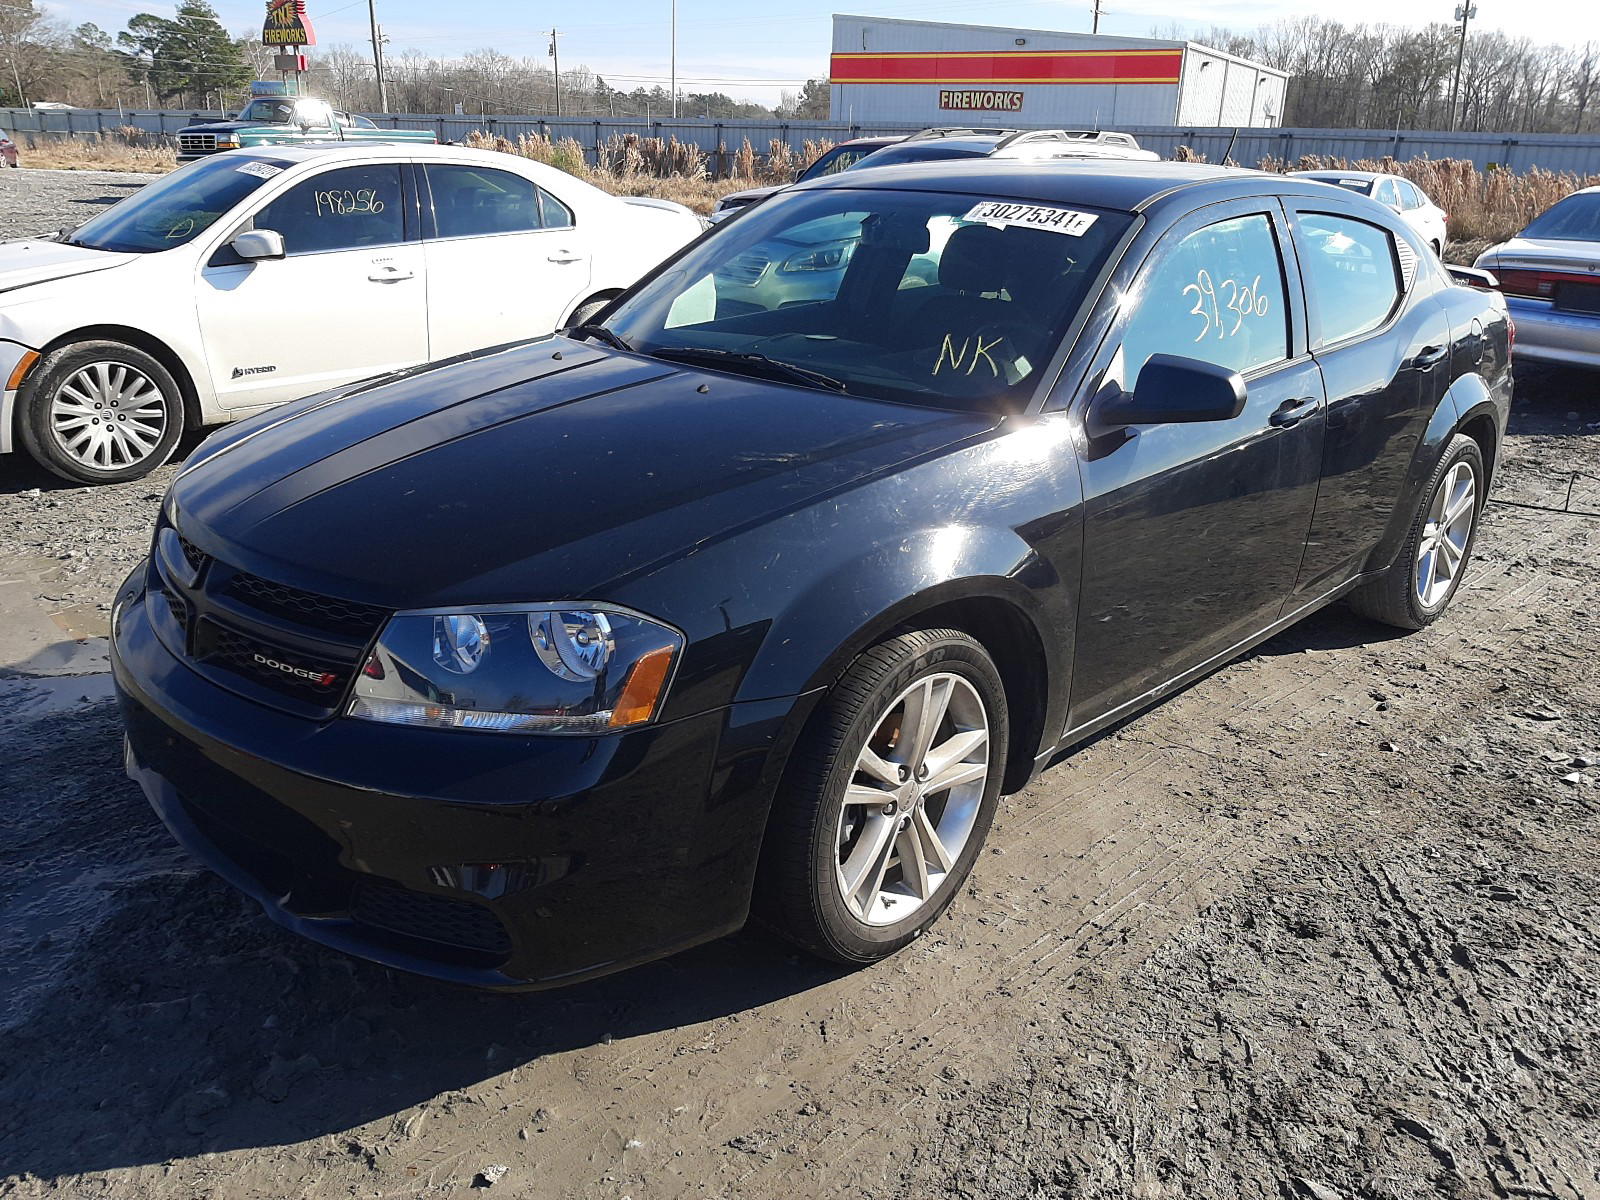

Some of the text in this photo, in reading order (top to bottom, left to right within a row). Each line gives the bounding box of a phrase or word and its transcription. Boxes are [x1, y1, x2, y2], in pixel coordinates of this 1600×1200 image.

[271, 2, 291, 27] TNT
[264, 28, 306, 44] FIREWORKS
[941, 91, 1022, 110] FIREWORKS
[314, 189, 385, 217] 198256
[931, 333, 1004, 378] NK
[244, 365, 277, 376] HYBRID
[253, 653, 322, 682] DODGE
